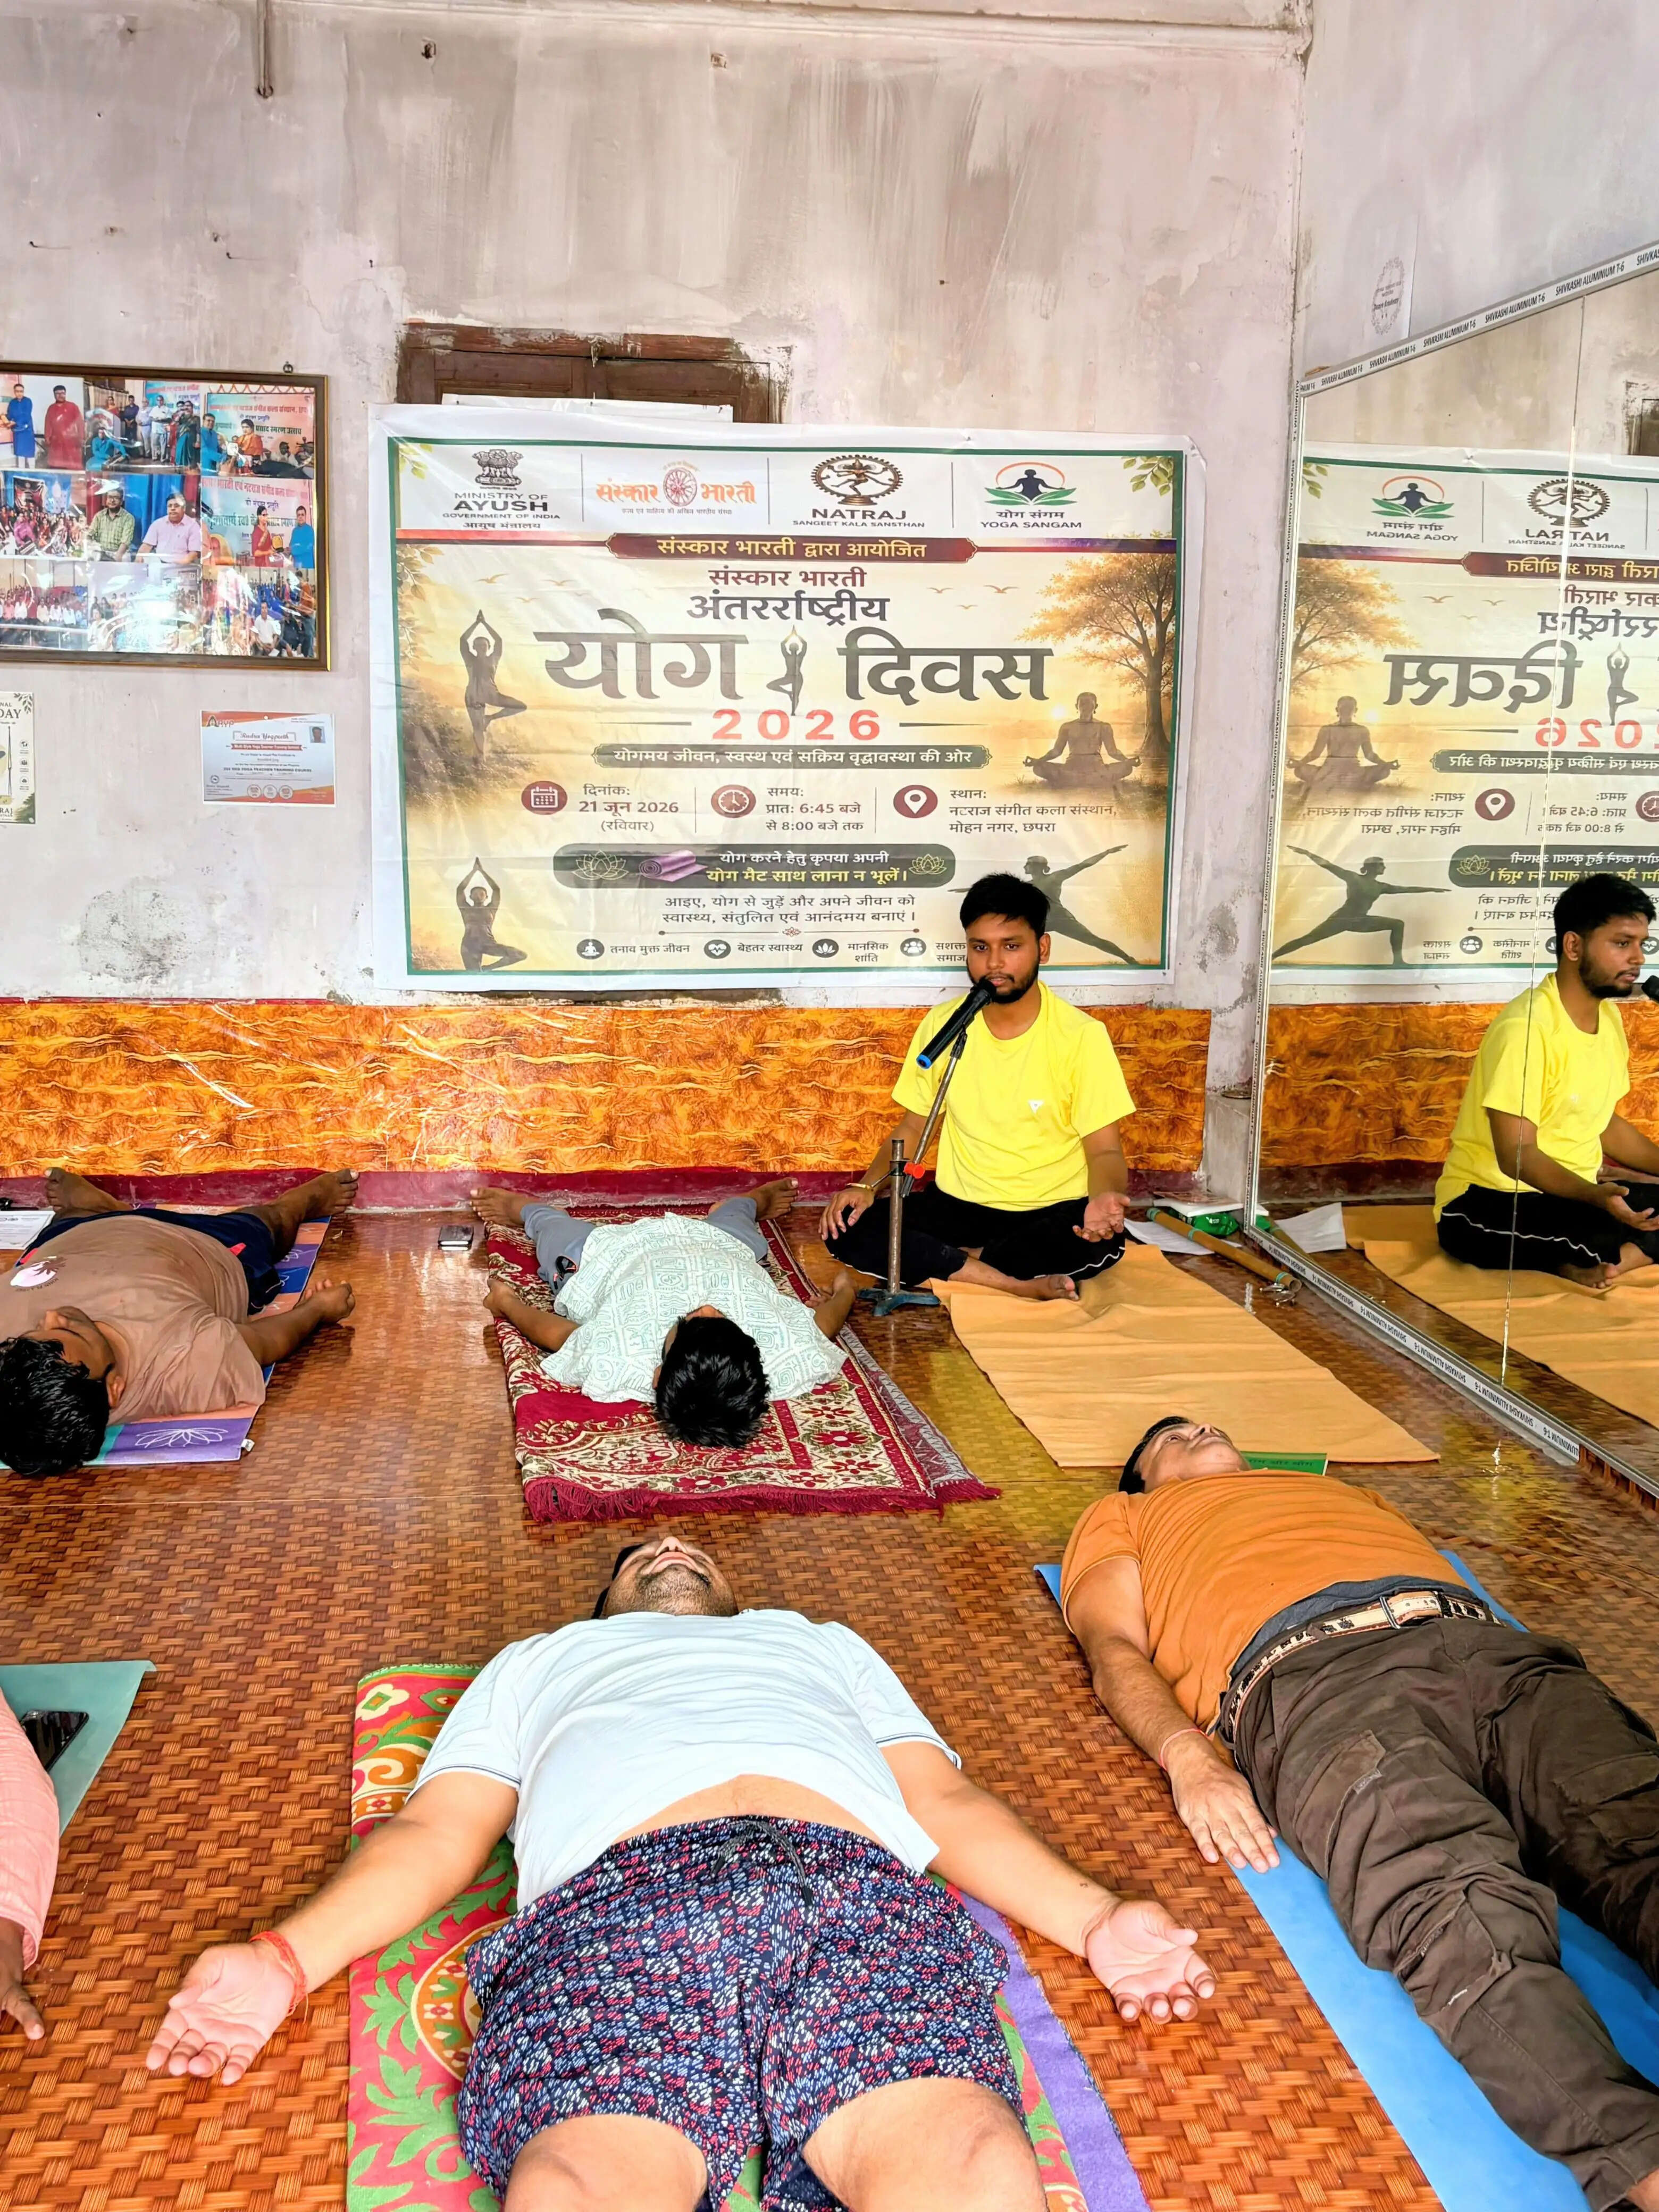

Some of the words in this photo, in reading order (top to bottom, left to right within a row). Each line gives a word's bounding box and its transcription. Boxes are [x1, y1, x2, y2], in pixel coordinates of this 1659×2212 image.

[1556, 277, 1582, 296] SHIVKASHI
[1582, 265, 1615, 286] ALUMINIUM
[1616, 261, 1625, 273] T-6
[1485, 308, 1508, 323] SHIVKASHI
[1509, 297, 1537, 314] ALUMINIUM
[596, 478, 661, 503] संस्कार
[700, 481, 757, 504] भारती
[454, 500, 548, 512] AYUSH
[996, 509, 1025, 518] योग
[1029, 509, 1065, 518] संगम
[812, 508, 907, 520] NATRAJ
[657, 536, 729, 555] संस्कार
[736, 536, 796, 556] भारती
[803, 542, 841, 558] द्वारा
[847, 539, 927, 558] आयोजित
[708, 565, 792, 586] संस्कार
[799, 566, 867, 588] भारती
[532, 608, 749, 699] योग
[836, 626, 1054, 706] दिवस
[711, 709, 881, 741] 2026
[613, 748, 669, 762] योगमय
[673, 748, 719, 764] जीवन,
[725, 750, 768, 763] स्वस्थ
[770, 749, 793, 763] एवं
[798, 749, 845, 763] सक्रिय
[849, 751, 915, 766] वृद्धावस्था
[920, 749, 940, 763] की
[944, 749, 973, 763] ओर
[583, 783, 630, 796] दिनांक:
[767, 787, 804, 797] समय:
[950, 790, 986, 799] स्थान:
[579, 801, 598, 812] 21
[603, 802, 632, 816] जून
[638, 802, 679, 813] 2026
[766, 804, 794, 814] प्रात:
[800, 803, 834, 813] 6:45
[839, 802, 861, 814] बजे
[949, 806, 992, 816] नटराज
[995, 803, 1032, 816] संगीत
[1036, 806, 1066, 815] कला
[1069, 803, 1117, 816] संस्थान,
[601, 819, 654, 832] (रविवार)
[766, 820, 777, 831] से
[782, 822, 814, 831] 8:00
[818, 820, 840, 831] बजे
[843, 822, 864, 831] तक
[949, 820, 982, 833] मोहन
[986, 823, 1018, 833] नगर,
[1023, 823, 1056, 832] छपरा
[719, 851, 746, 864] योग
[750, 851, 785, 863] करने
[786, 851, 806, 866] हेतु
[810, 853, 849, 866] कृपया
[852, 850, 890, 864] अपनी
[706, 868, 739, 883] योग
[744, 869, 768, 883] मैट
[772, 870, 806, 883] साथ
[810, 870, 849, 883] लाना
[852, 870, 865, 882] न
[665, 897, 706, 908] आइए,
[711, 896, 738, 907] योग
[744, 895, 756, 907] से
[790, 895, 815, 907] और
[819, 895, 851, 907] अपने
[856, 894, 892, 906] जीवन
[898, 894, 916, 906] को
[722, 910, 774, 925] संतुलित
[778, 911, 799, 923] एवं
[805, 911, 866, 923] आनंदमय
[640, 945, 660, 956] मुक्त
[663, 942, 690, 953] जीवन
[738, 942, 765, 953] बेहतर
[848, 941, 889, 951] मानसिक
[935, 942, 966, 950] सशक्त
[854, 952, 878, 962] शांति
[936, 954, 966, 962] समाज
[1420, 1348, 1444, 1368] ALUMINIUM
[1444, 1363, 1466, 1383] SHIVKASHI
[1481, 1389, 1509, 1410] ALUMINIUM
[1509, 1405, 1534, 1428] SHIVKASHI
[1551, 1432, 1579, 1456] LUMINIUM
